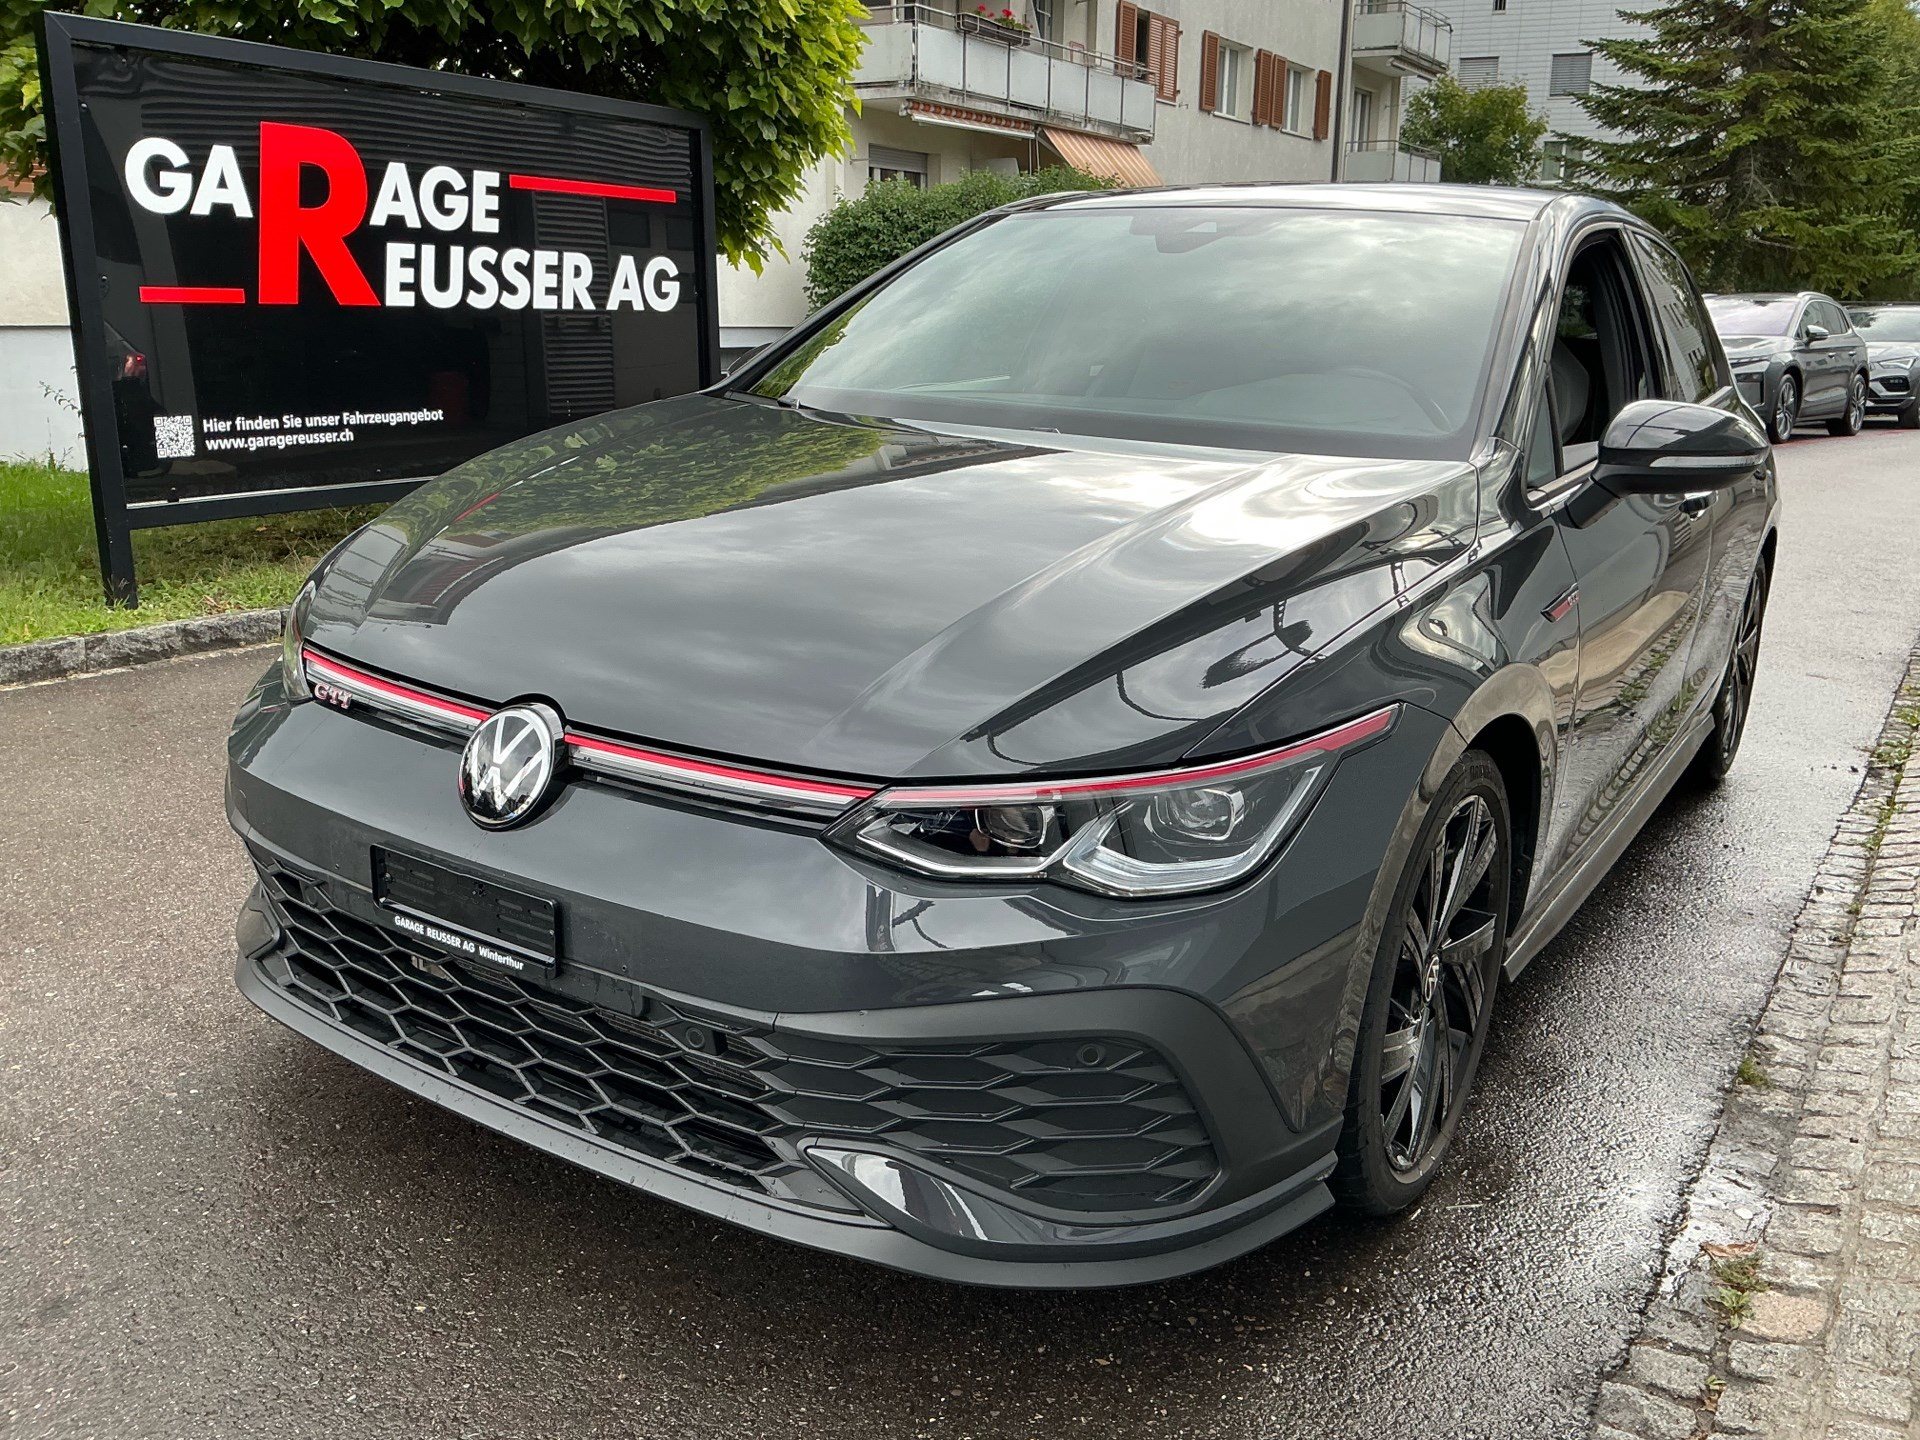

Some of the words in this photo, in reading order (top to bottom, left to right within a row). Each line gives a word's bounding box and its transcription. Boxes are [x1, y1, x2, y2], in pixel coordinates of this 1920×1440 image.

[124, 121, 500, 306] GARAGE
[606, 254, 680, 312] AG
[202, 417, 232, 433] Hier
[235, 414, 280, 431] finden
[282, 414, 302, 429] Sie
[305, 414, 341, 427] unser
[342, 408, 444, 426] Fahrzeugangebot
[205, 428, 354, 451] www.garagereusser.ch
[314, 682, 352, 709] GTI
[394, 915, 425, 935] GARAGE
[426, 927, 461, 949] REUSSER
[462, 940, 475, 953] AG
[478, 946, 525, 971] Winterthur
